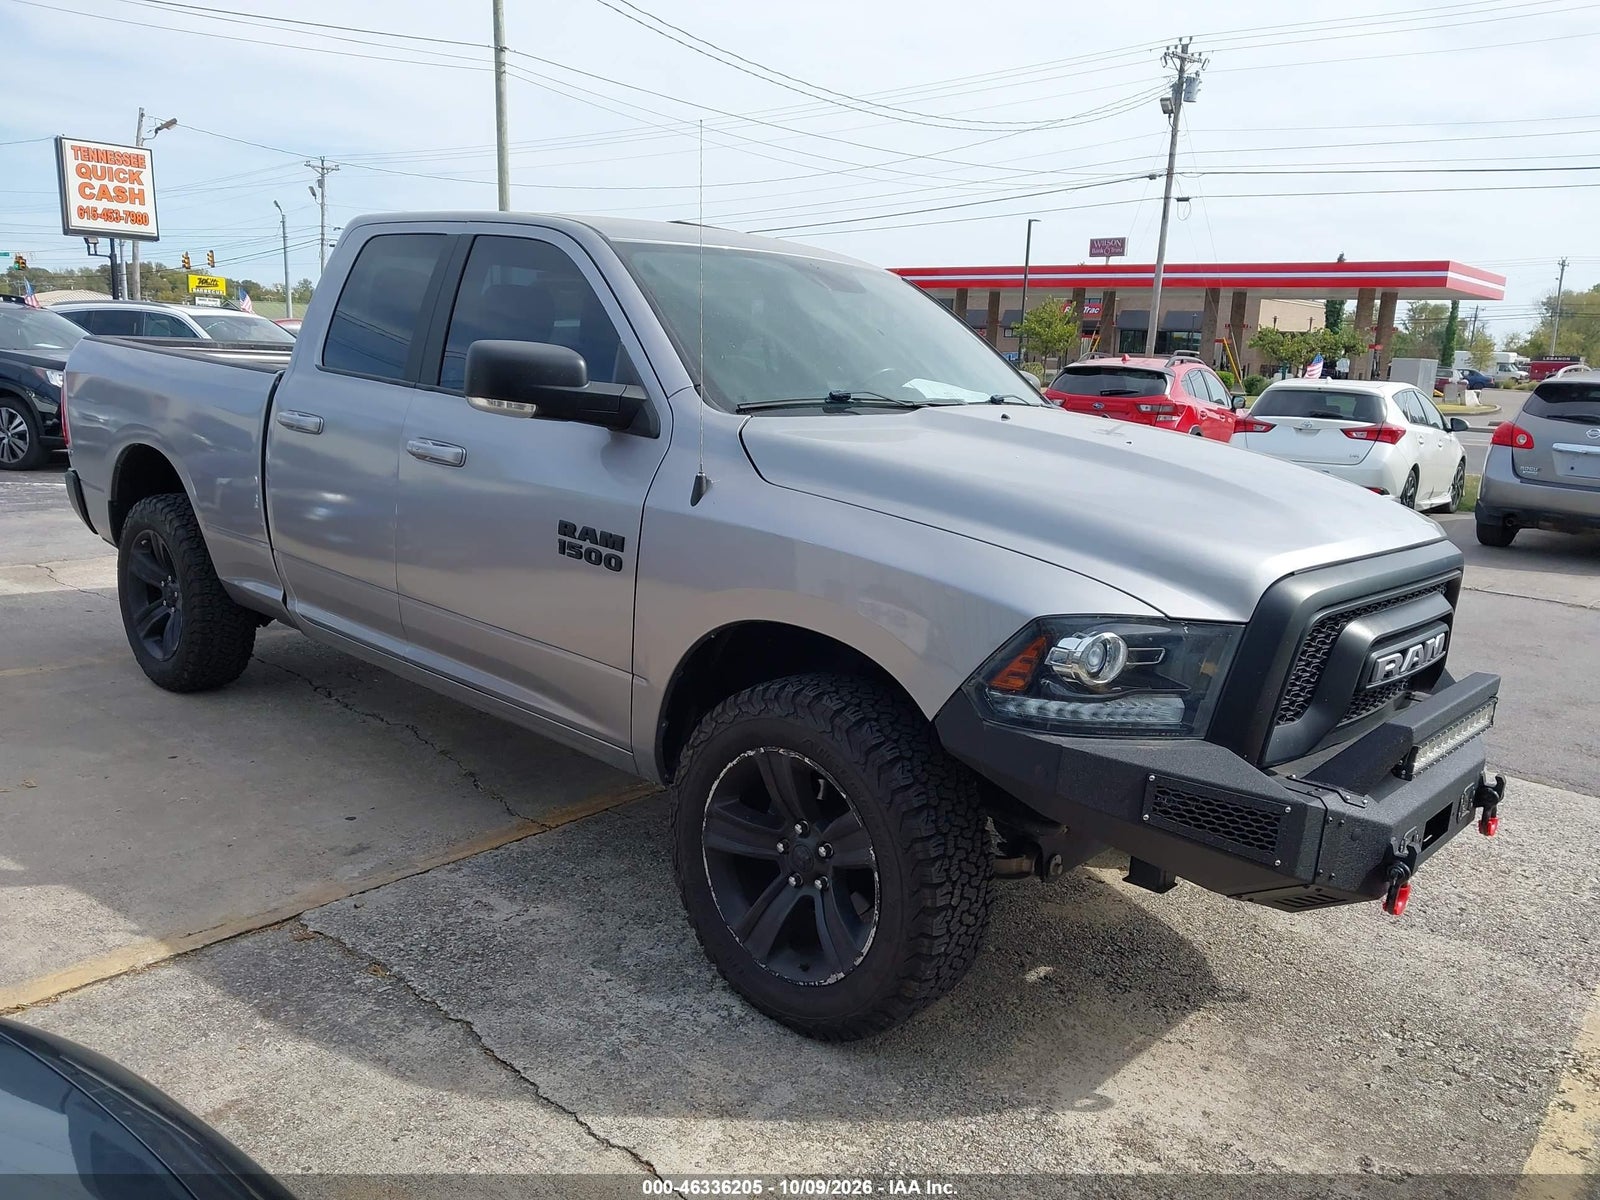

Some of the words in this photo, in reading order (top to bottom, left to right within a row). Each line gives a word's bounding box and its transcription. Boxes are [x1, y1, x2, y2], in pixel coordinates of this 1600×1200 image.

[71, 145, 146, 169] TENNESSEE
[75, 163, 144, 185] QUICK
[78, 182, 145, 205] CASH
[77, 205, 149, 226] 615-453-7980
[558, 519, 626, 553] RAM
[557, 538, 623, 573] 1500
[1371, 632, 1448, 684] RAM
